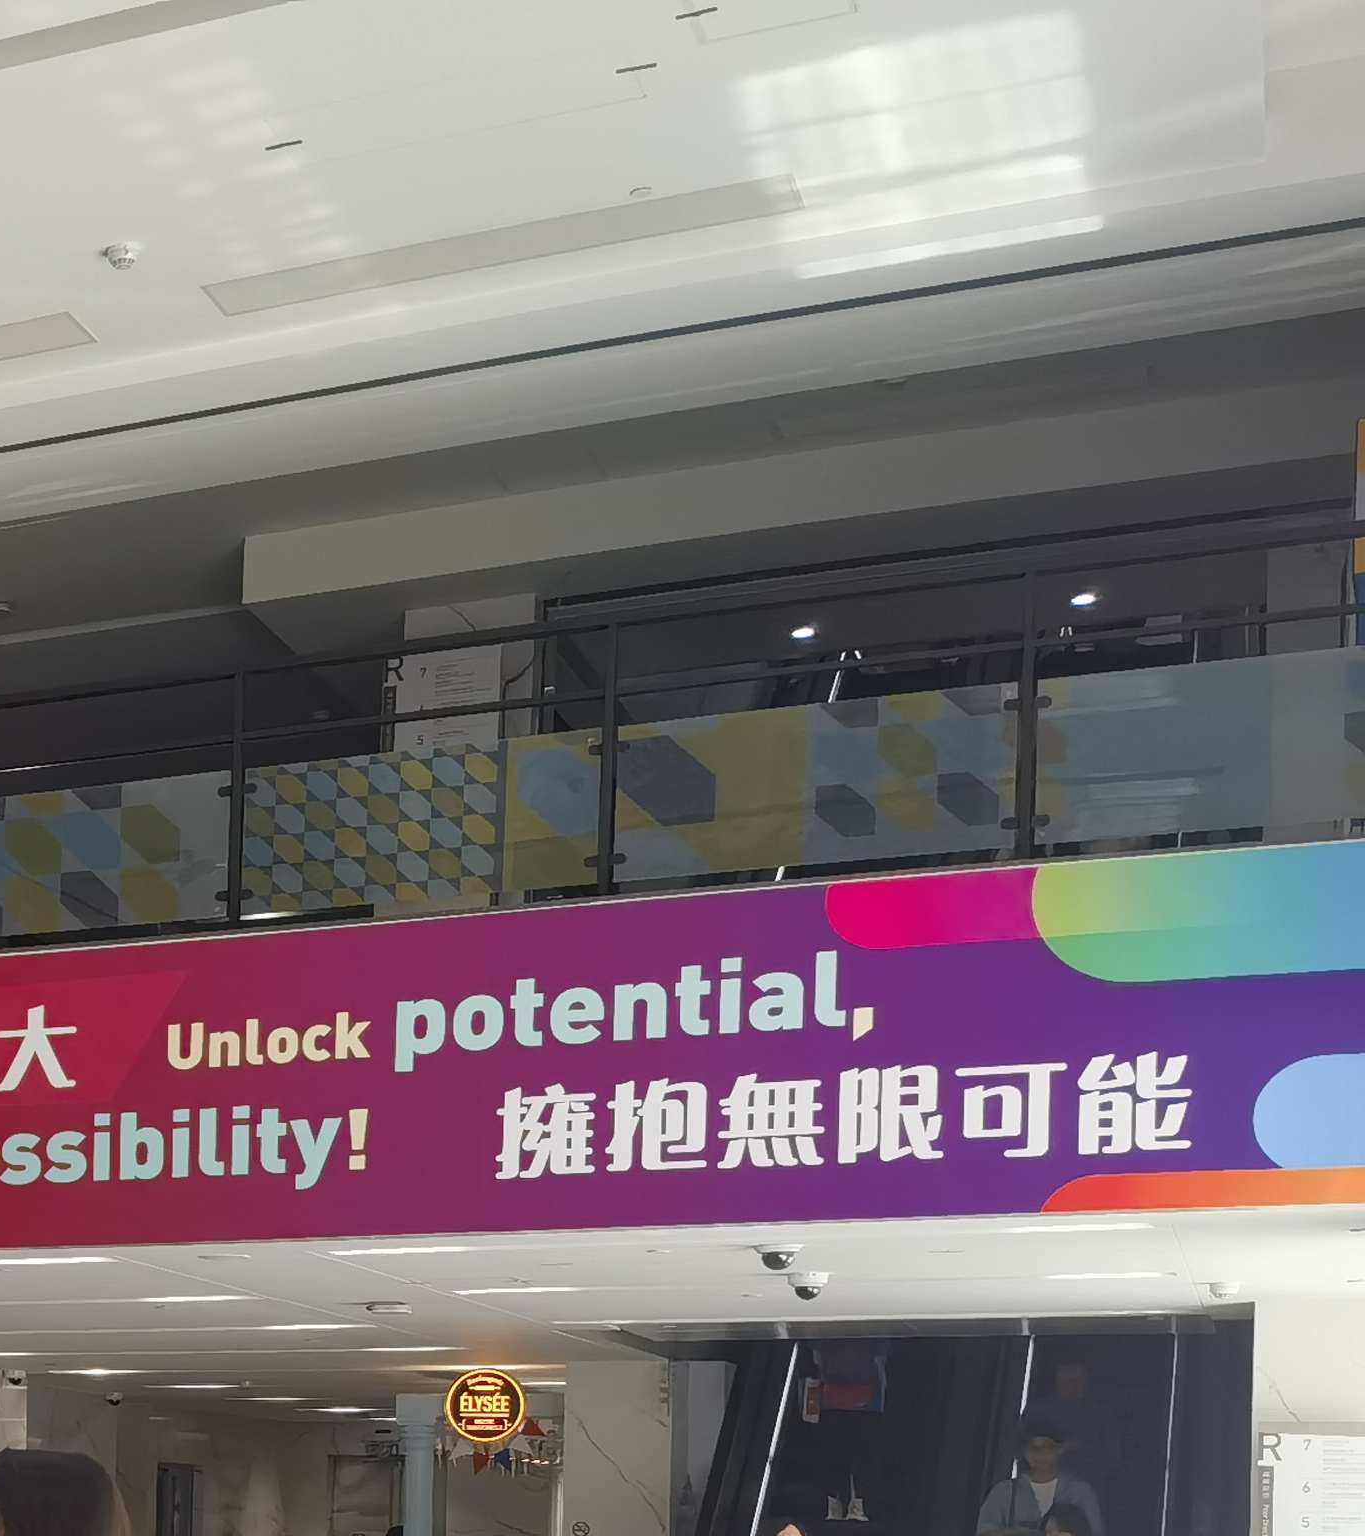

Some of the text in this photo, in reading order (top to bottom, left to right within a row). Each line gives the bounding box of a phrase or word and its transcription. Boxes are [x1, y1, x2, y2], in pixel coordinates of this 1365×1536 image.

[168, 950, 874, 1072] Unlock potential,
[496, 1051, 1192, 1180] 擁抱無限可能
[459, 1391, 510, 1412] ÉLYSÉE
[1303, 1439, 1311, 1451] 7
[1302, 1481, 1310, 1493] 6
[1301, 1516, 1309, 1528] 5
